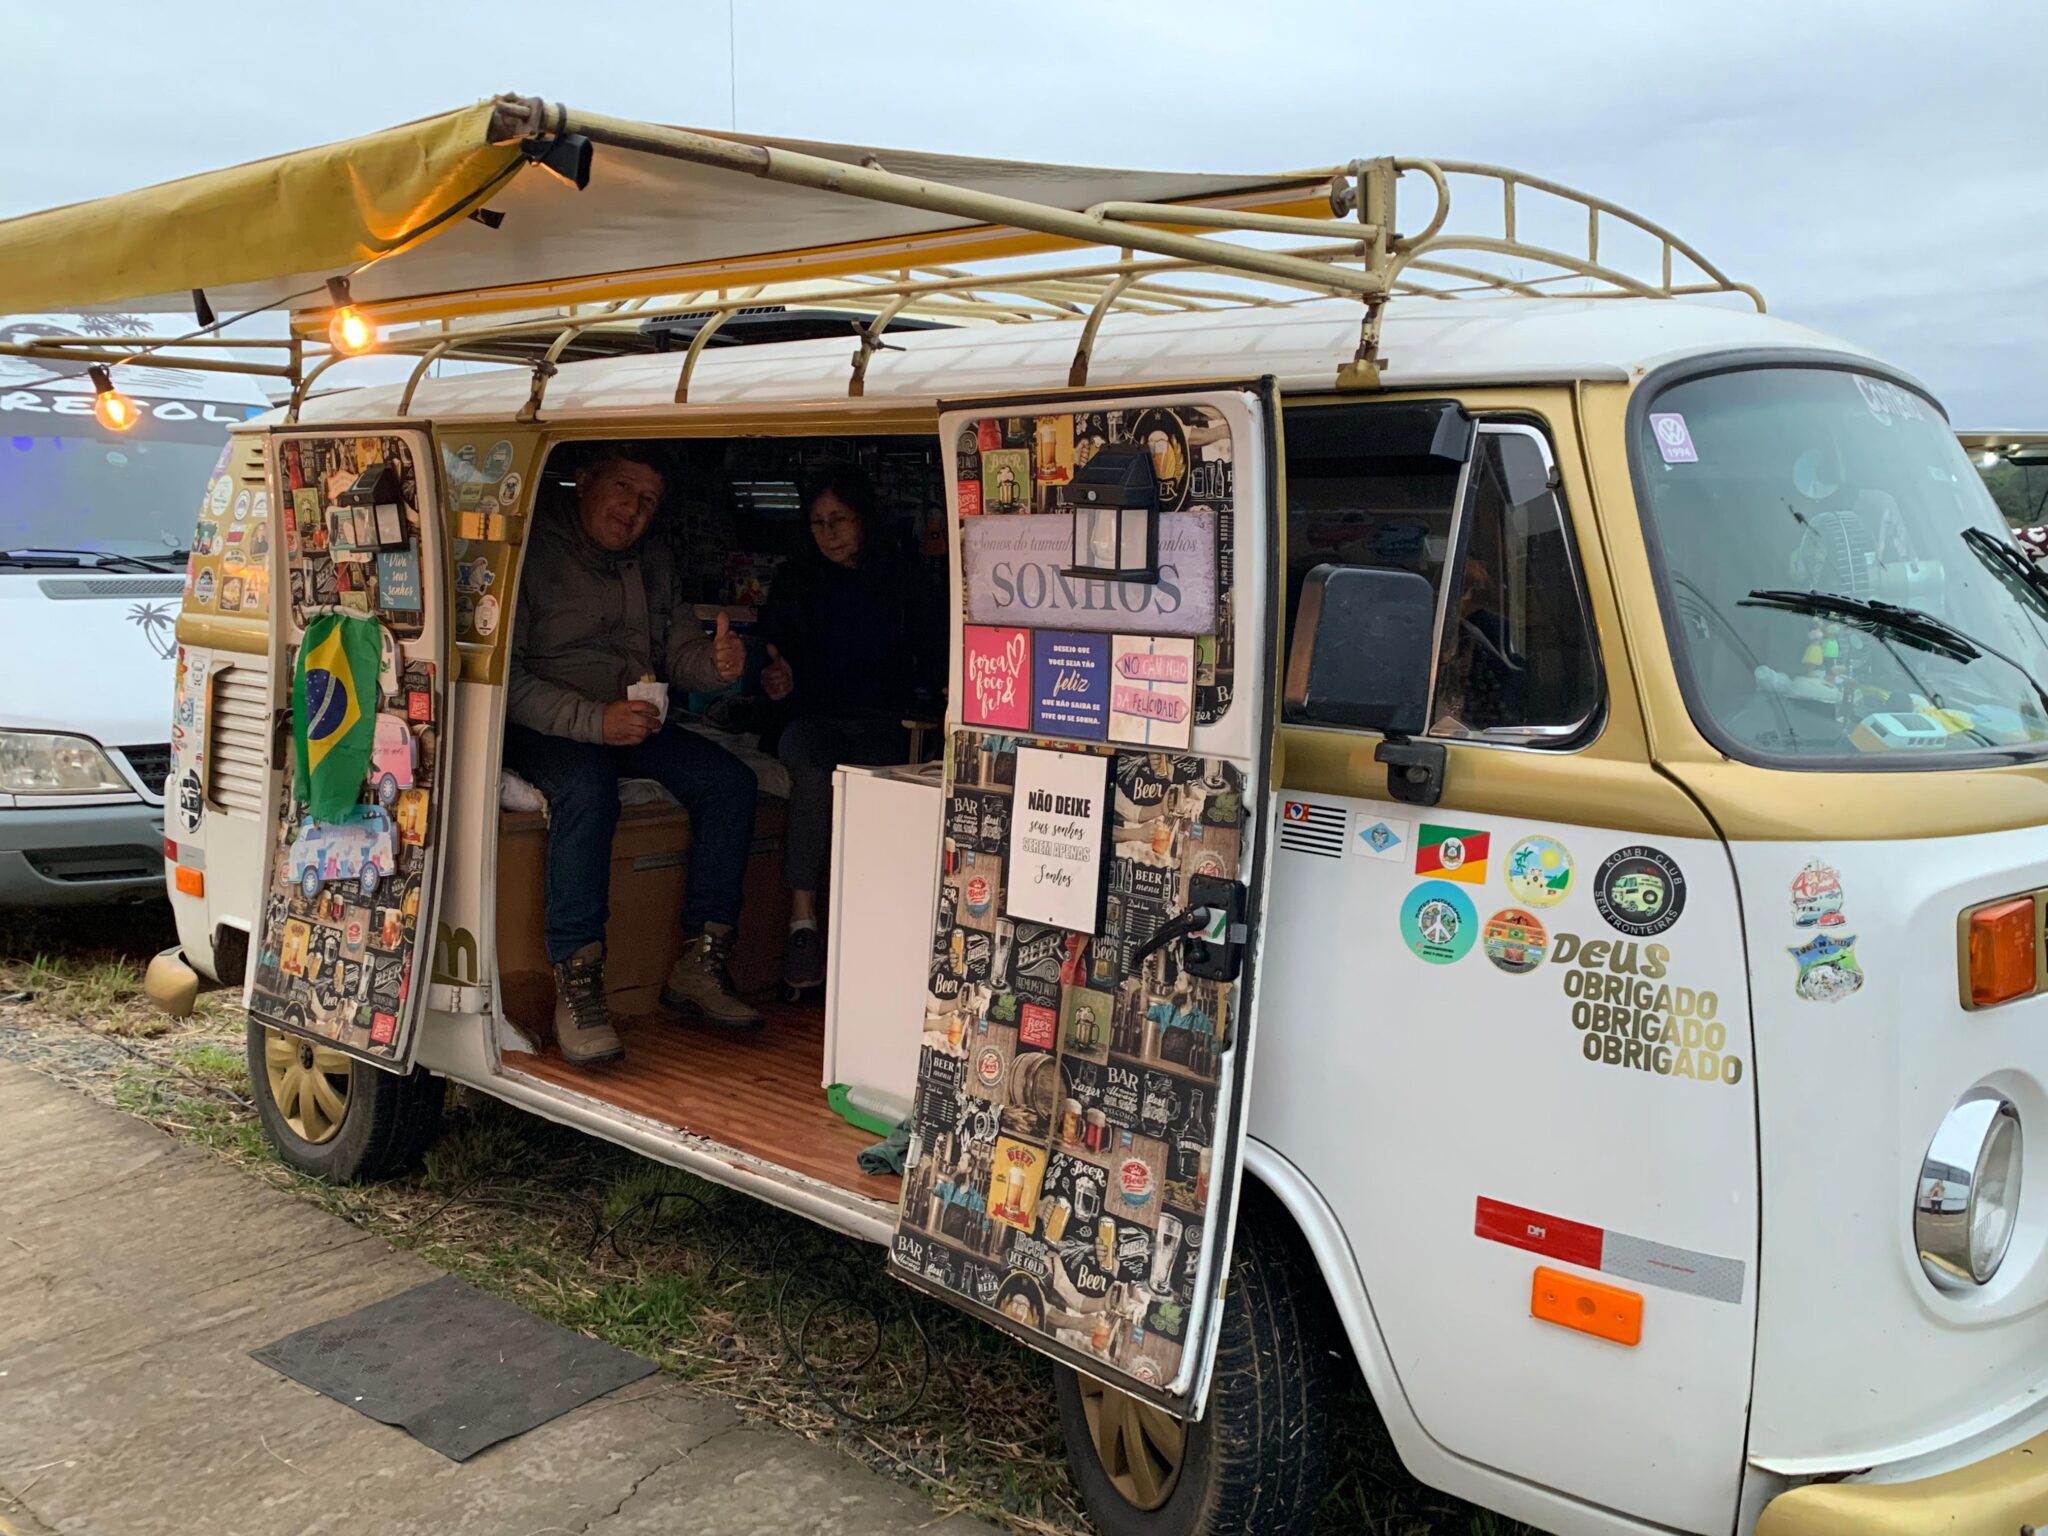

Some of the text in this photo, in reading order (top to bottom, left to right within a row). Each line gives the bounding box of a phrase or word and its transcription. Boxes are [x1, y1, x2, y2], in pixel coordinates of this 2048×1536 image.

[1160, 530, 1198, 552] onhos
[991, 561, 1182, 615] SONHOS
[1077, 646, 1090, 654] QUE
[1123, 656, 1141, 675] NO
[1053, 668, 1091, 698] feliz
[1132, 692, 1180, 719] FELICIDADE
[1133, 777, 1163, 801] Beer
[954, 797, 978, 816] BAR
[1028, 789, 1091, 818] NÃO DEIXE
[1028, 820, 1086, 841] seus sonhos
[1022, 836, 1091, 862] SEREM APENAS
[1033, 863, 1074, 888] Sonhos
[1135, 869, 1162, 885] BEER
[1605, 848, 1648, 868] KOMBI
[1655, 854, 1683, 885] CLUB
[1135, 882, 1161, 895] menu
[1595, 890, 1678, 935] SEM FRONTEIRAS
[935, 974, 958, 994] Beer
[1563, 969, 1719, 1021] OBRIGADO
[1572, 1001, 1726, 1052] OBRIGADO
[933, 1056, 955, 1072] BEER
[1582, 1033, 1743, 1085] OBRIGADO
[1107, 1067, 1138, 1092] BAR
[1070, 1160, 1106, 1187] BEER
[898, 1235, 923, 1261] BAR
[1010, 1251, 1022, 1266] ICE
[1077, 1264, 1107, 1292] Beer
